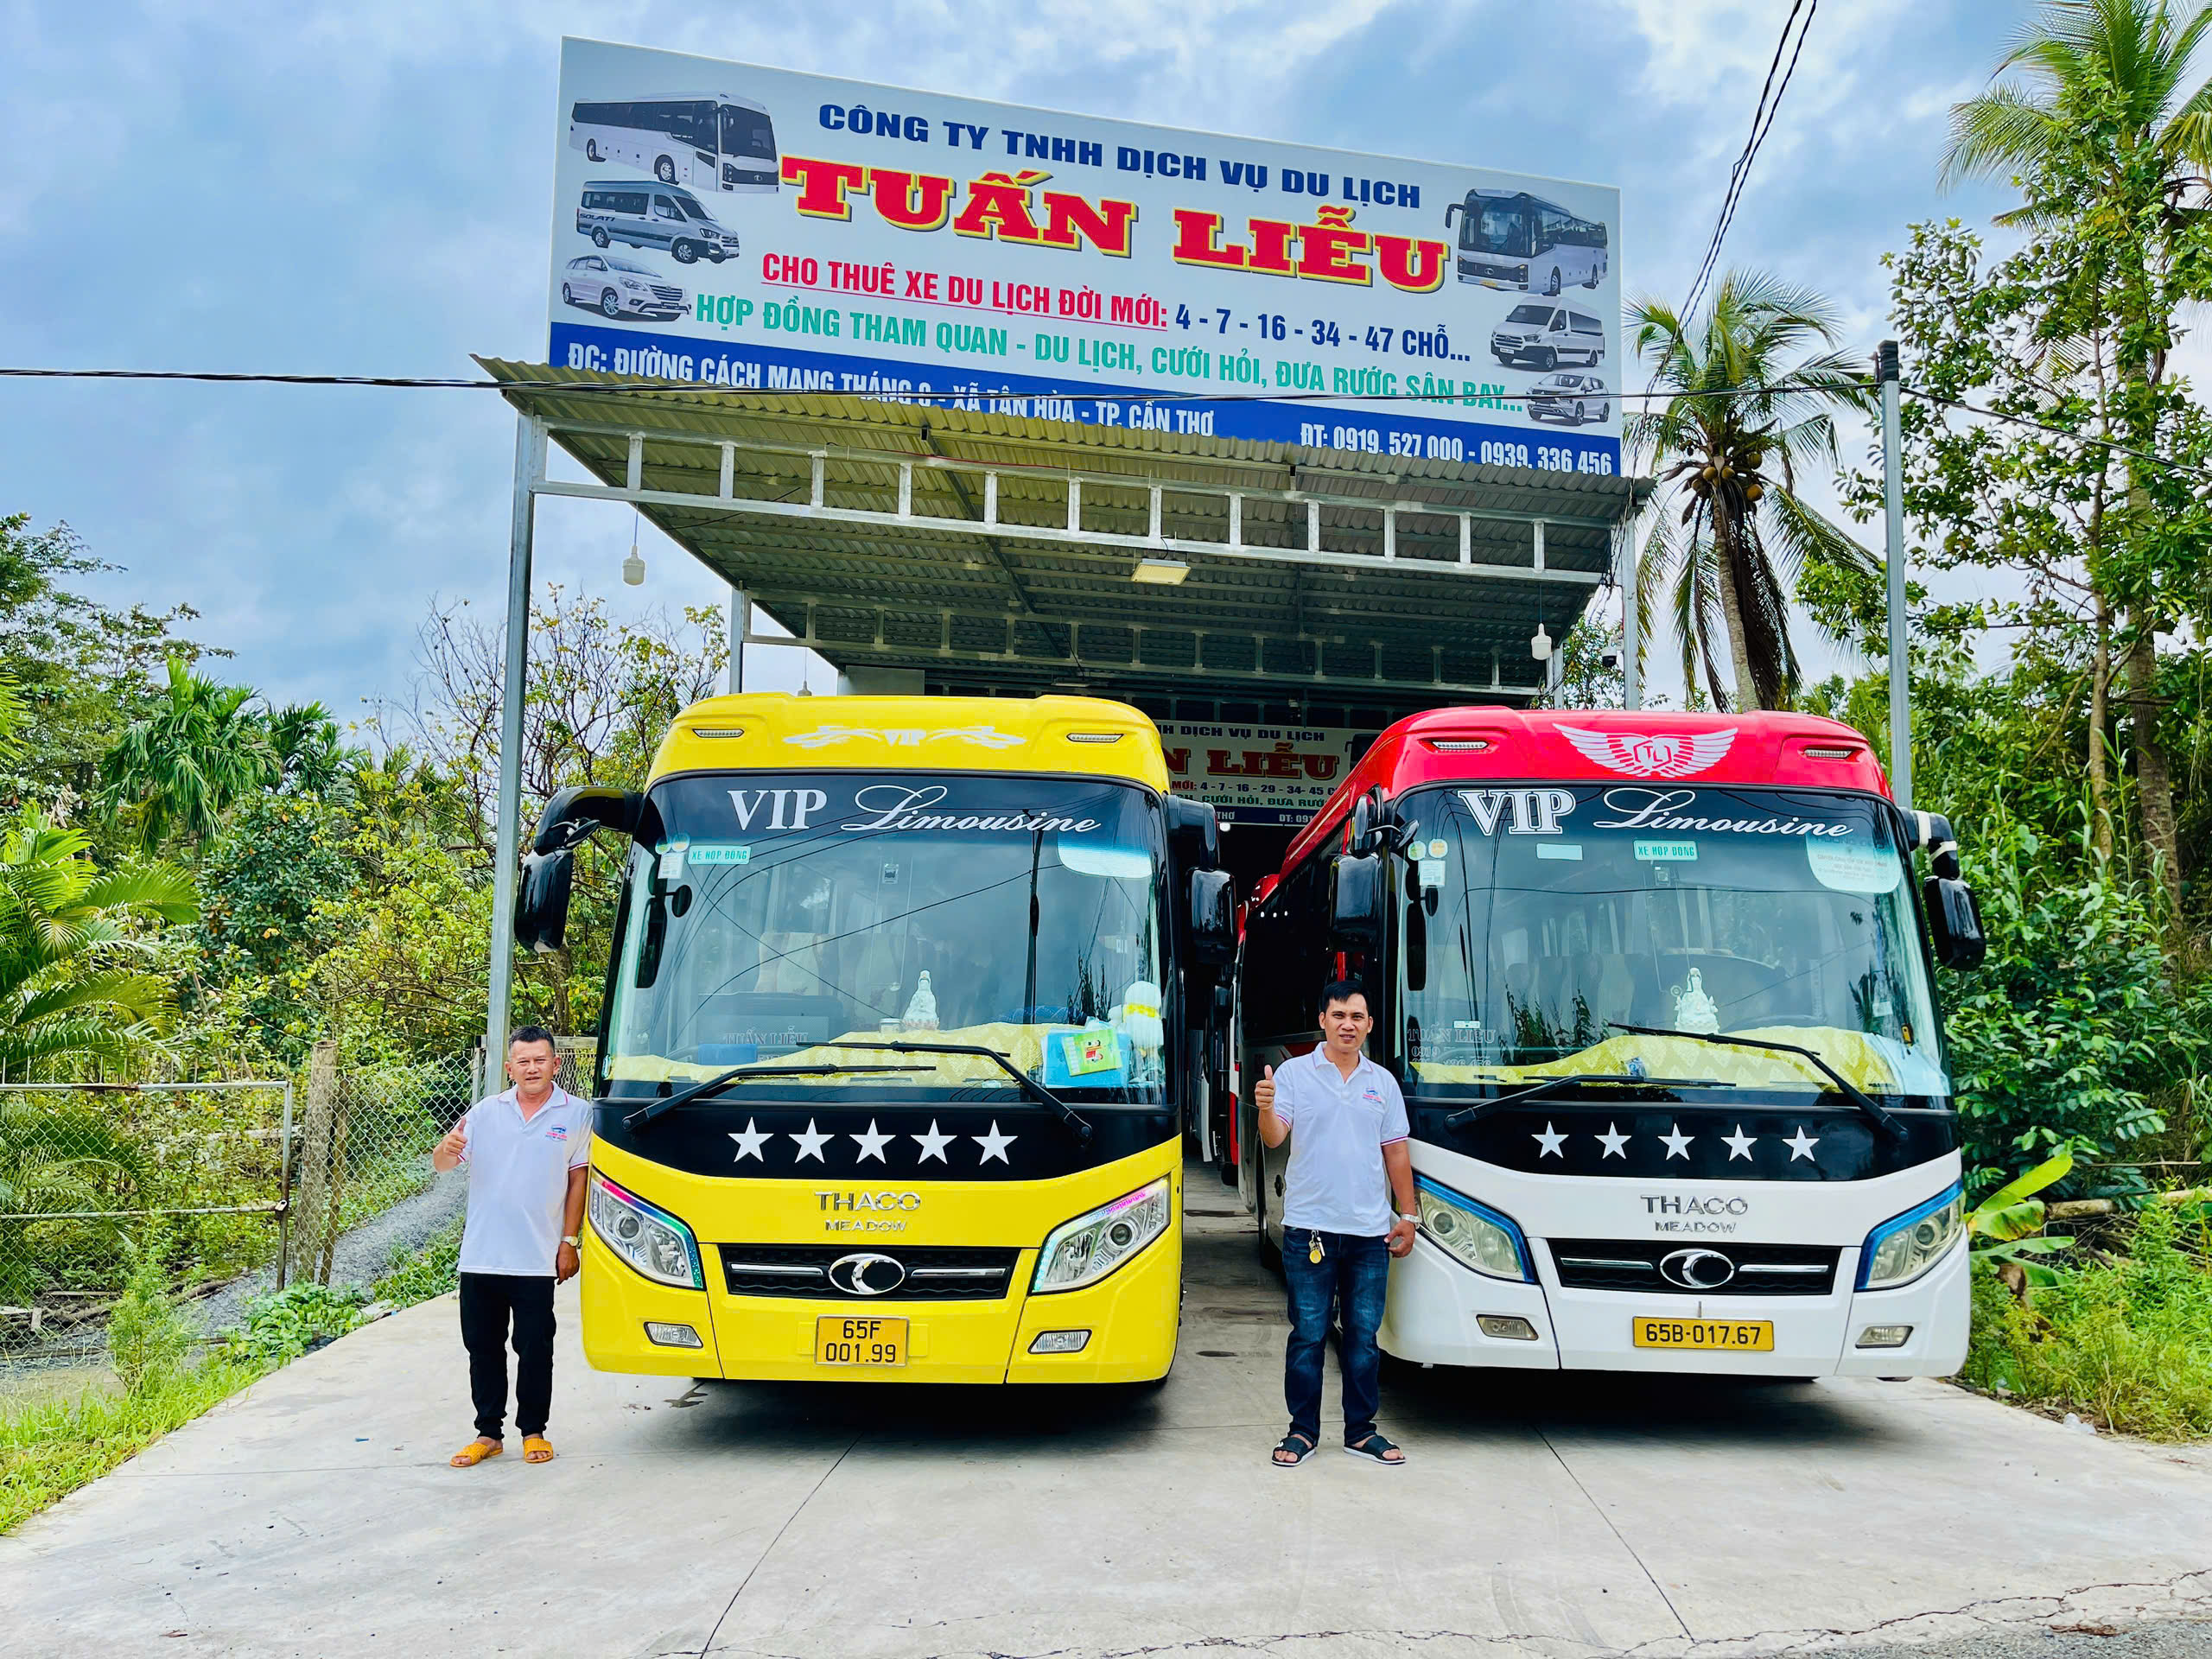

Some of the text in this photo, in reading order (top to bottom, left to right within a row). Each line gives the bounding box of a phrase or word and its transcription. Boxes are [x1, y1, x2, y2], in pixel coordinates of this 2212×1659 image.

[819, 104, 1421, 209] CÔNG TY TNHH DỊCH VỤ DU LỊCH
[780, 155, 1451, 295] TUẤN LIỄU
[762, 252, 818, 286] CHO
[828, 258, 895, 296] THUÊ
[905, 270, 938, 300] XE
[948, 275, 983, 305] DU
[992, 282, 1051, 316] LỊCH
[1058, 283, 1102, 321] ĐỜI
[1110, 291, 1167, 328] MỚI:
[1175, 303, 1191, 330] 4
[1217, 308, 1230, 334] 7
[1258, 313, 1286, 340] 16
[1311, 319, 1341, 347] 34
[1365, 326, 1394, 353] 47
[1401, 323, 1471, 362] CHỖ...
[696, 293, 753, 331] HỢP
[762, 295, 840, 337] ĐỒNG
[852, 310, 926, 347] THAM
[936, 322, 1007, 356] QUAN
[1035, 333, 1070, 363] DU
[1078, 338, 1142, 374] LỊCH,
[1151, 343, 1211, 380] CƯỚI
[1219, 347, 1268, 389] HỎI,
[1274, 359, 1326, 392] ĐƯA
[1333, 365, 1397, 397] RƯỚC
[1405, 372, 1454, 405] SÂN
[1462, 380, 1522, 412] BAY...
[568, 342, 607, 373] ĐC:
[613, 345, 694, 382] ĐƯỜNG
[700, 353, 761, 389] CÁCH
[952, 382, 981, 413] XÃ
[1095, 401, 1122, 427] TP.
[1176, 410, 1215, 437] THƠ
[1300, 423, 1329, 449] ĐT:
[1332, 426, 1383, 455] 0919.
[1389, 432, 1422, 458] 527
[1427, 436, 1464, 463] 000
[1480, 441, 1534, 469] 0939.
[1537, 446, 1573, 474] 336
[1578, 451, 1611, 476] 456
[884, 728, 926, 747] VIP
[1180, 725, 1223, 738] DỊCH
[1228, 728, 1252, 740] VỤ
[1257, 729, 1281, 739] DU
[1286, 730, 1325, 742] LỊCH
[1207, 742, 1339, 780] LIỄU
[1171, 780, 1198, 791] MỚI:
[1200, 781, 1208, 791] 4
[1219, 782, 1225, 791] 7
[1237, 783, 1249, 792] 16
[1261, 784, 1275, 793] 29
[1309, 785, 1324, 795] 45
[727, 784, 1103, 833] VIP Limousine
[1202, 794, 1233, 804] CƯỚI
[1268, 798, 1294, 807] ĐƯA
[1298, 798, 1328, 808] RƯỚ
[1457, 786, 1854, 837] VIP Limousine
[1216, 810, 1236, 820] THƠ
[1295, 815, 1313, 823] 091
[1637, 846, 1649, 856] XE
[814, 1192, 921, 1212] THACO
[1640, 1194, 1748, 1216] THACO
[824, 1219, 907, 1232] MEADOW
[1654, 1220, 1738, 1234] MEADOW
[842, 1319, 881, 1341] 65F
[1644, 1322, 1762, 1346] 65B-017.67
[824, 1343, 897, 1364] 001.99
